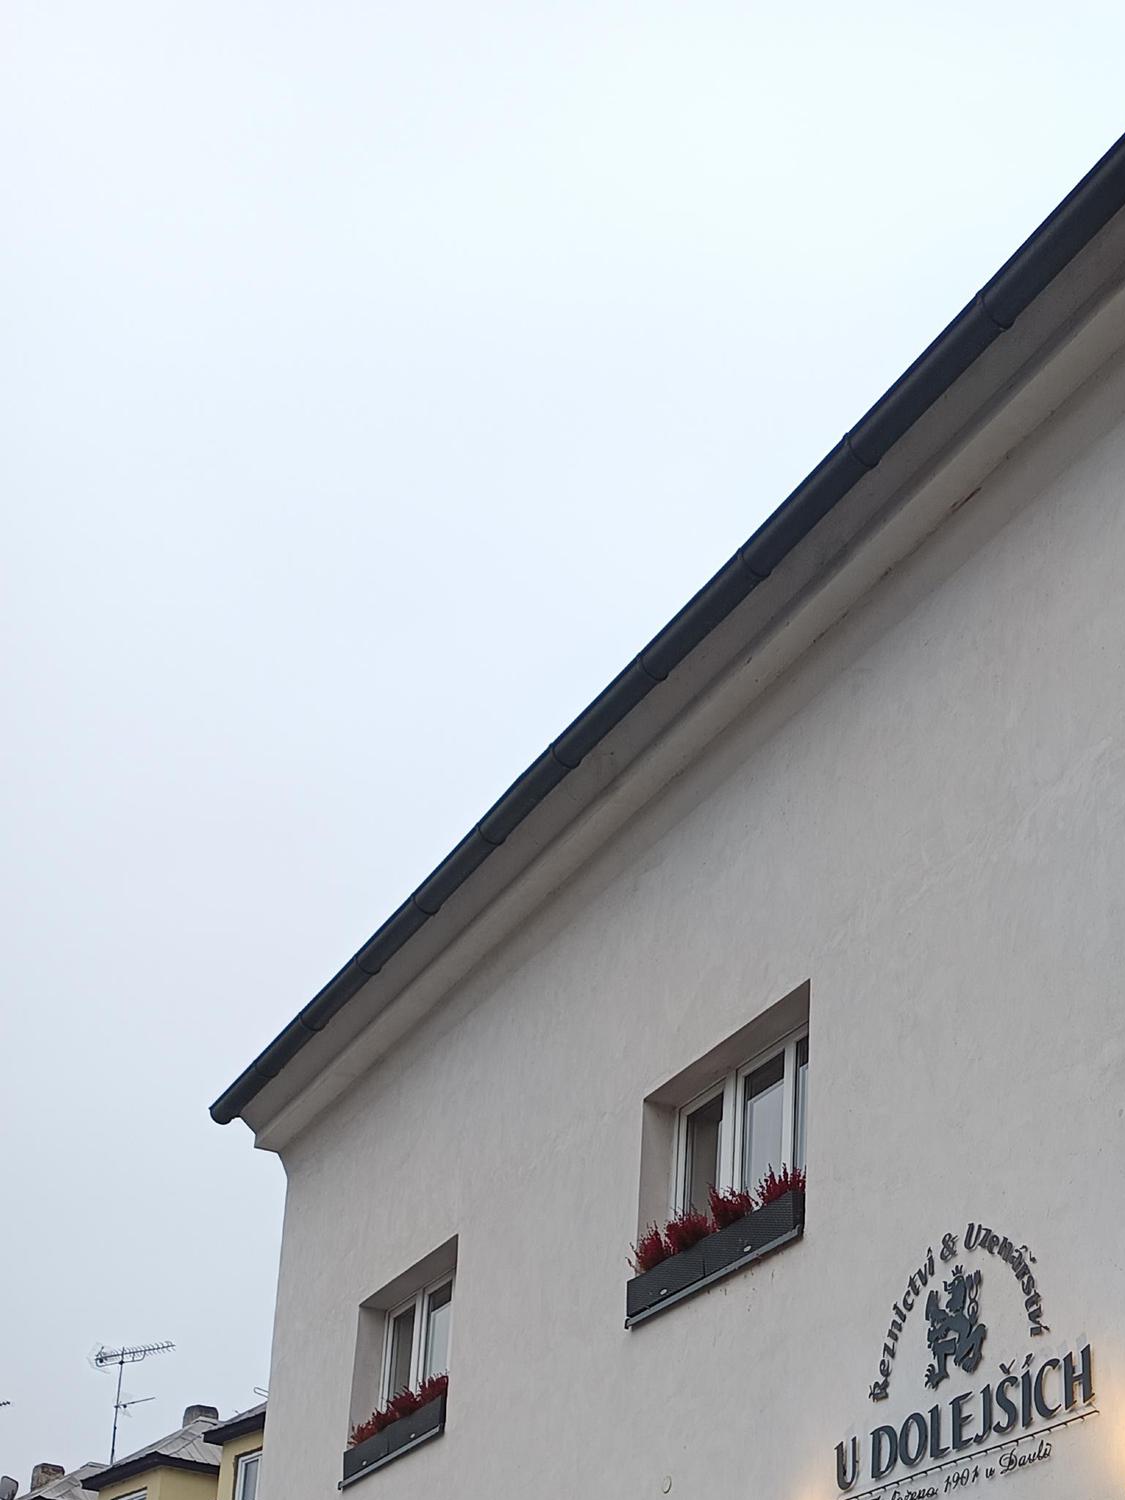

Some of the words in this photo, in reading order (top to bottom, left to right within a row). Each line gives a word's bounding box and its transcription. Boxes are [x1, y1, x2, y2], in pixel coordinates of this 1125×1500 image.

[869, 1246, 935, 1402] Řeznictví
[940, 1232, 958, 1262] &
[964, 1222, 1050, 1338] Uzenářství
[834, 1436, 858, 1492] U
[870, 1344, 1096, 1480] DOLEJŠÍCH
[944, 1465, 980, 1493] 1901
